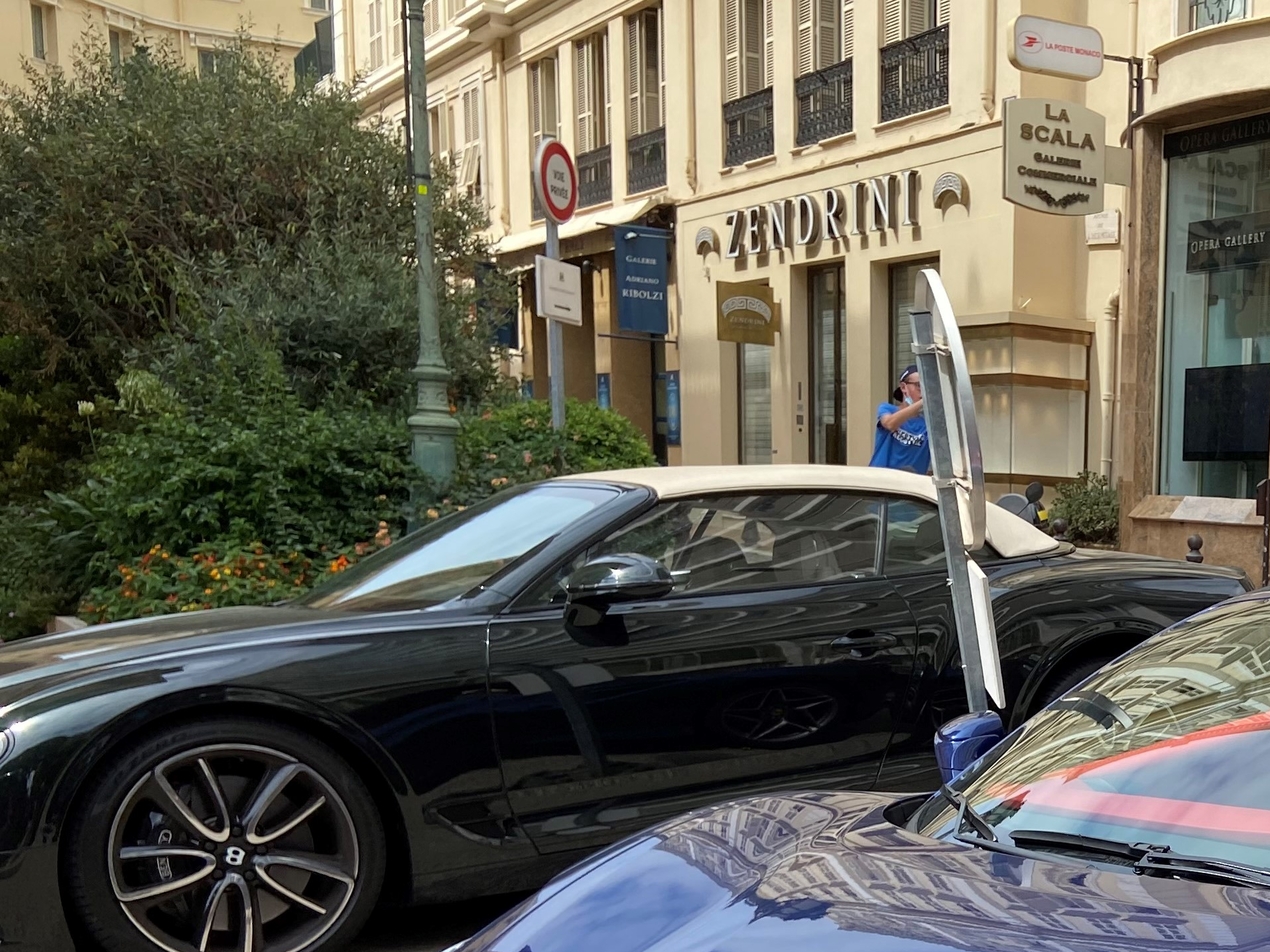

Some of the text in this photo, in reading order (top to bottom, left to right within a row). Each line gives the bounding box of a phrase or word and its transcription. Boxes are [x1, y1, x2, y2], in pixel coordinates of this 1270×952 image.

[1045, 42, 1100, 58] LA POSTE MONACO
[1045, 104, 1070, 123] LA
[1020, 123, 1096, 151] SCALA
[1180, 133, 1217, 152] OPERA
[1033, 152, 1081, 169] GALERIE
[1017, 165, 1097, 187] COMMERCIALE
[726, 170, 920, 259] ZENDRINI
[1191, 232, 1266, 254] OPERA GALLERY
[626, 255, 657, 265] GALERIE
[622, 289, 663, 300] RIBOLZI
